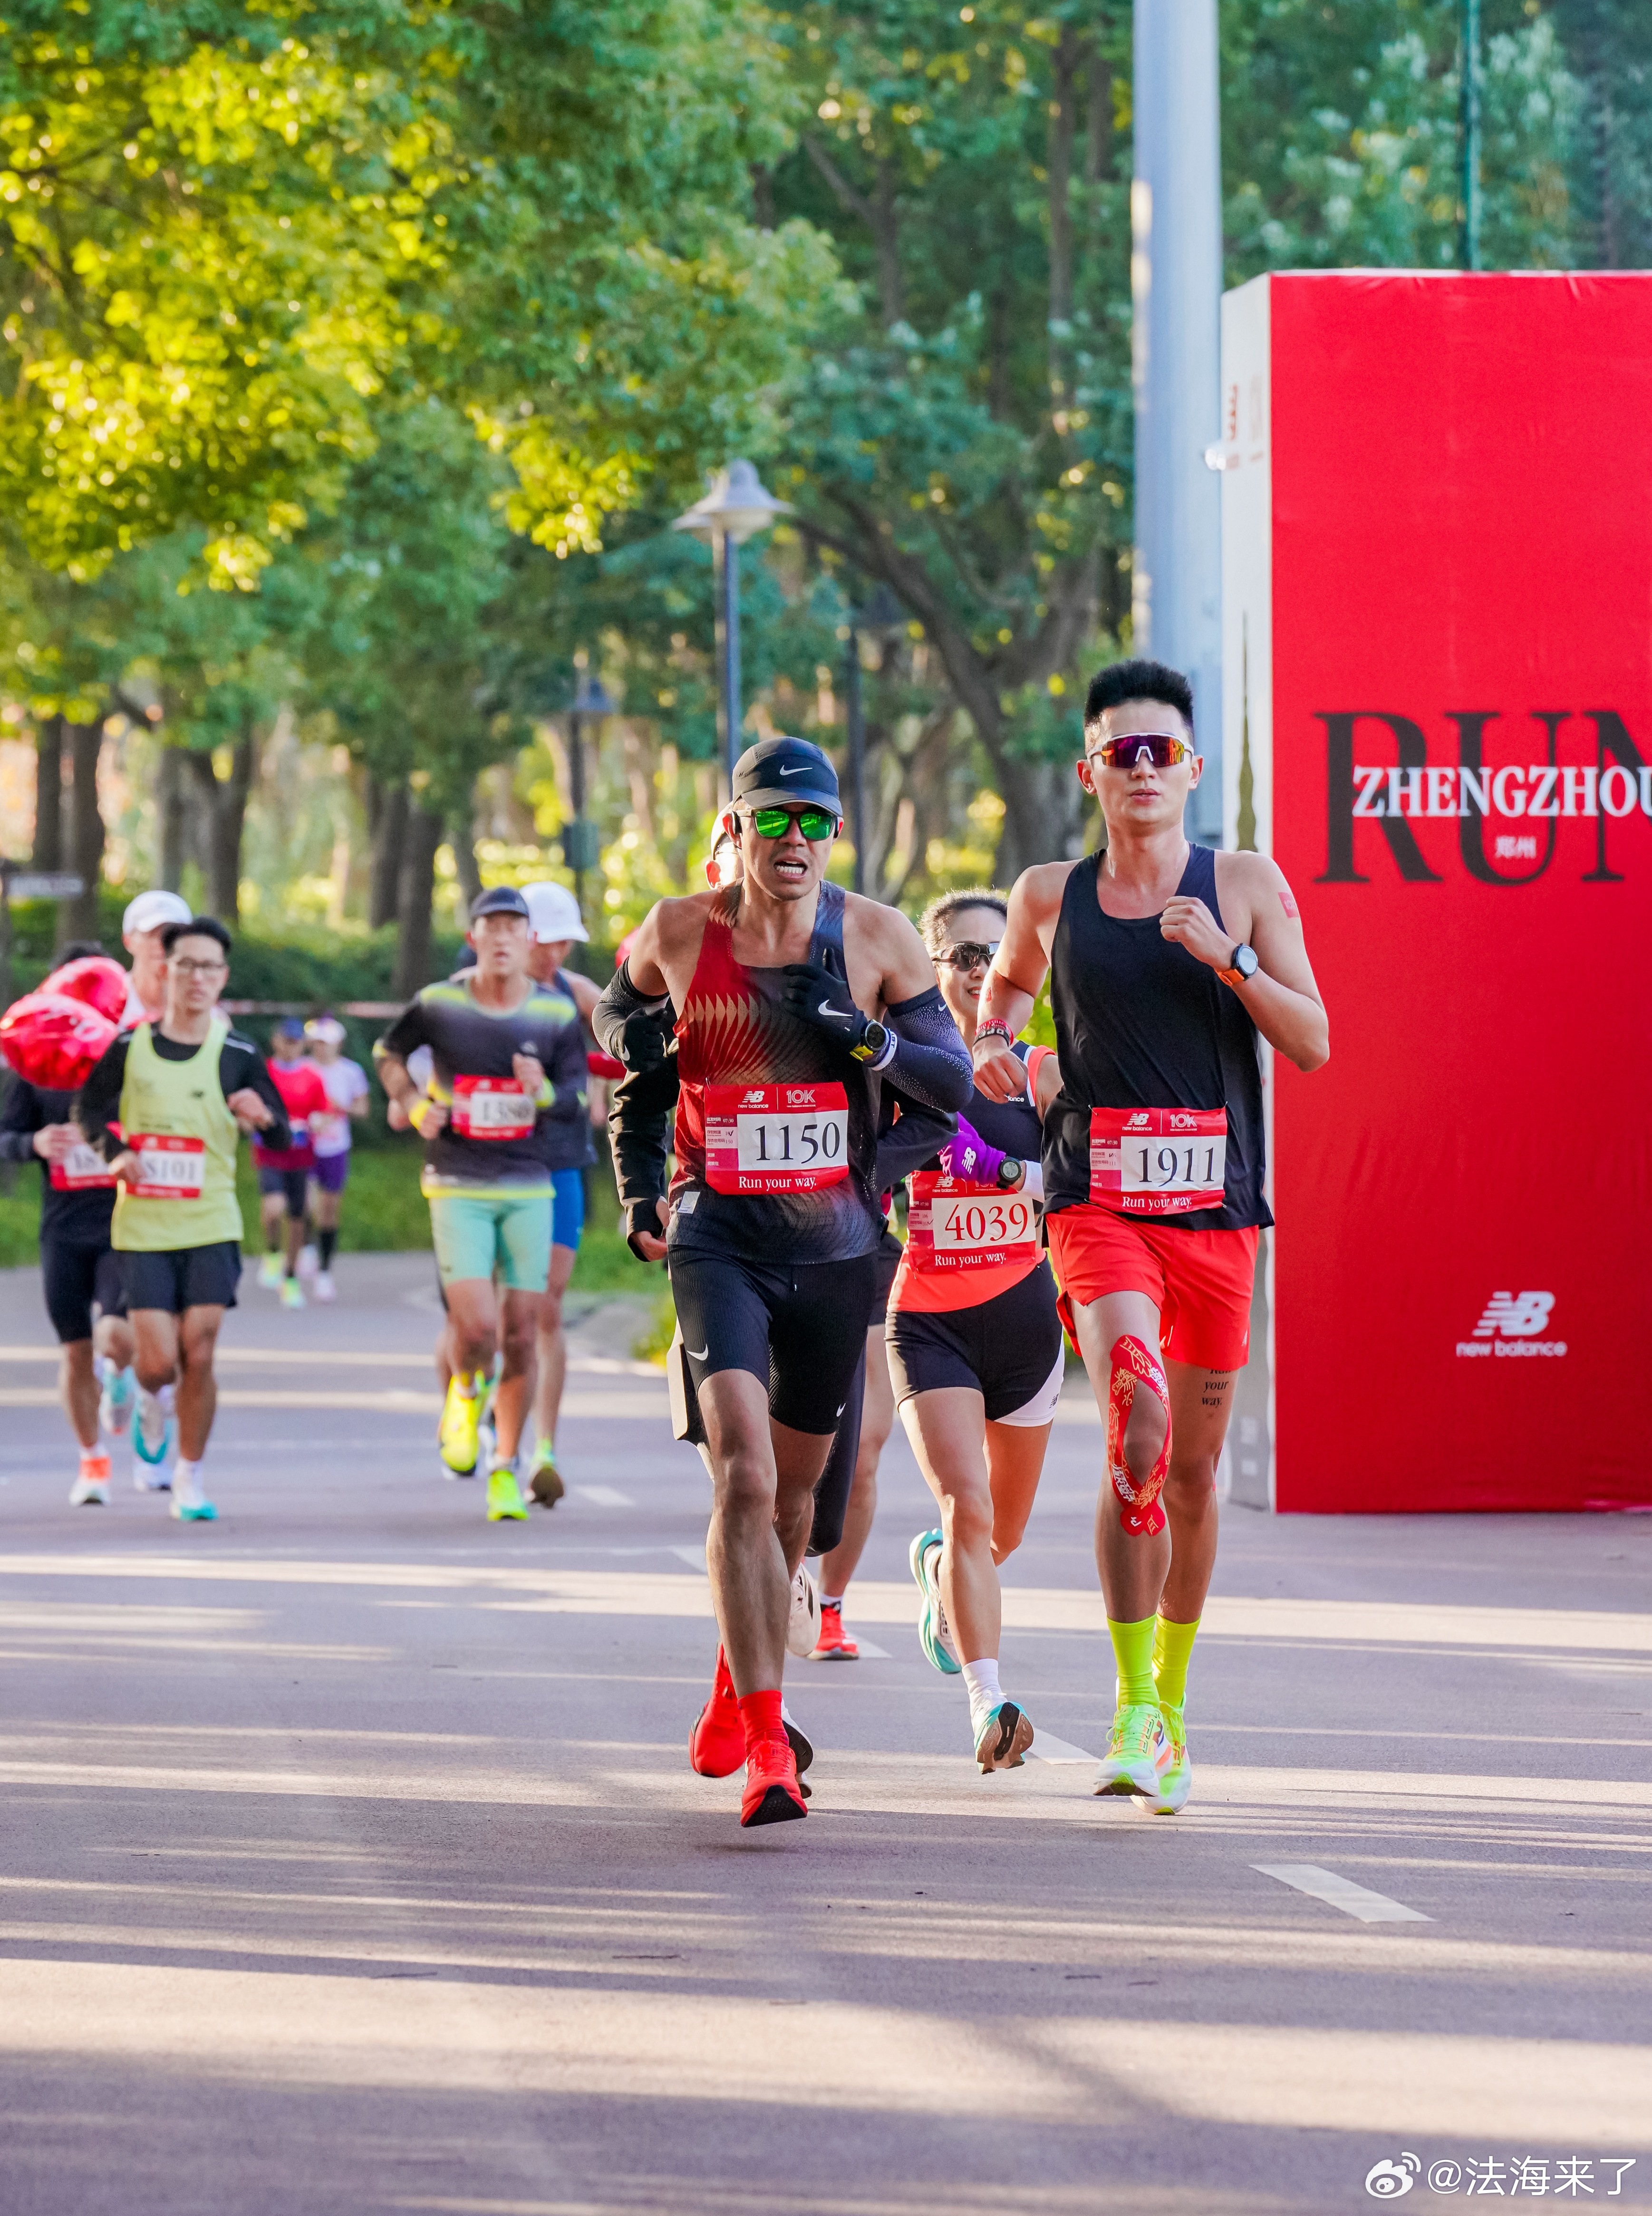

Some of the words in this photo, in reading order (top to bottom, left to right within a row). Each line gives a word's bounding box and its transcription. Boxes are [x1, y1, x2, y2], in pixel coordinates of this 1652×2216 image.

[786, 1089, 816, 1104] 10K
[1170, 1113, 1198, 1128] 10K
[755, 1122, 840, 1164] 1150
[1138, 1147, 1215, 1187] 1911
[738, 1176, 762, 1188] Run
[765, 1178, 792, 1192] your
[794, 1177, 817, 1189] way.
[1122, 1196, 1145, 1208] Run
[1148, 1198, 1170, 1211] your
[1172, 1197, 1192, 1209] way.
[945, 1203, 1028, 1242] 4039
[935, 1254, 956, 1266] Run
[958, 1255, 983, 1268] your
[985, 1253, 1006, 1264] way.
[1456, 1341, 1492, 1357] new
[1494, 1339, 1568, 1357] balance
[1203, 1381, 1229, 1393] your
[1202, 1397, 1223, 1408] way.
